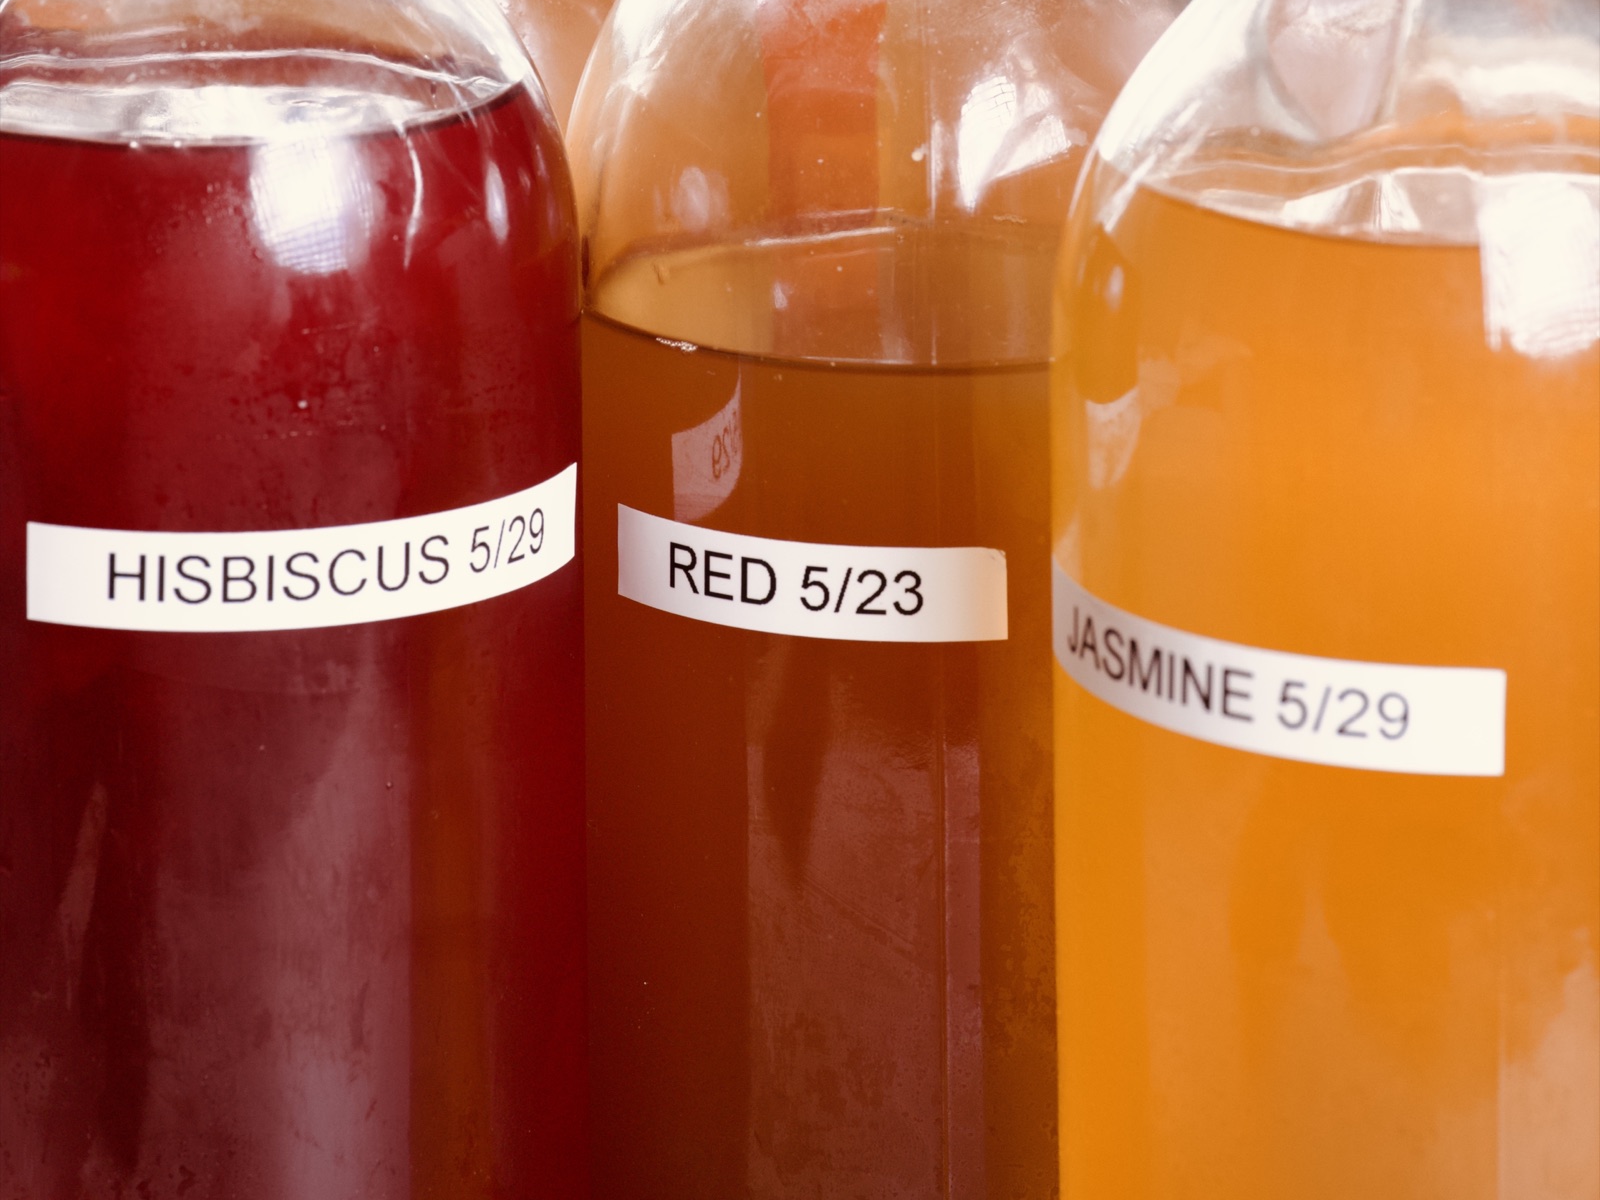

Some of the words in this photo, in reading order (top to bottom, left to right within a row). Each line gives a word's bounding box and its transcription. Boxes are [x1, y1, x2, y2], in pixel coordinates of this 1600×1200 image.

[108, 535, 450, 605] HISBISCUS
[469, 507, 546, 574] 5/29
[669, 541, 777, 606] RED
[800, 565, 924, 616] 5/23
[1067, 606, 1255, 723] JASMINE
[1277, 680, 1411, 741] 5/29
